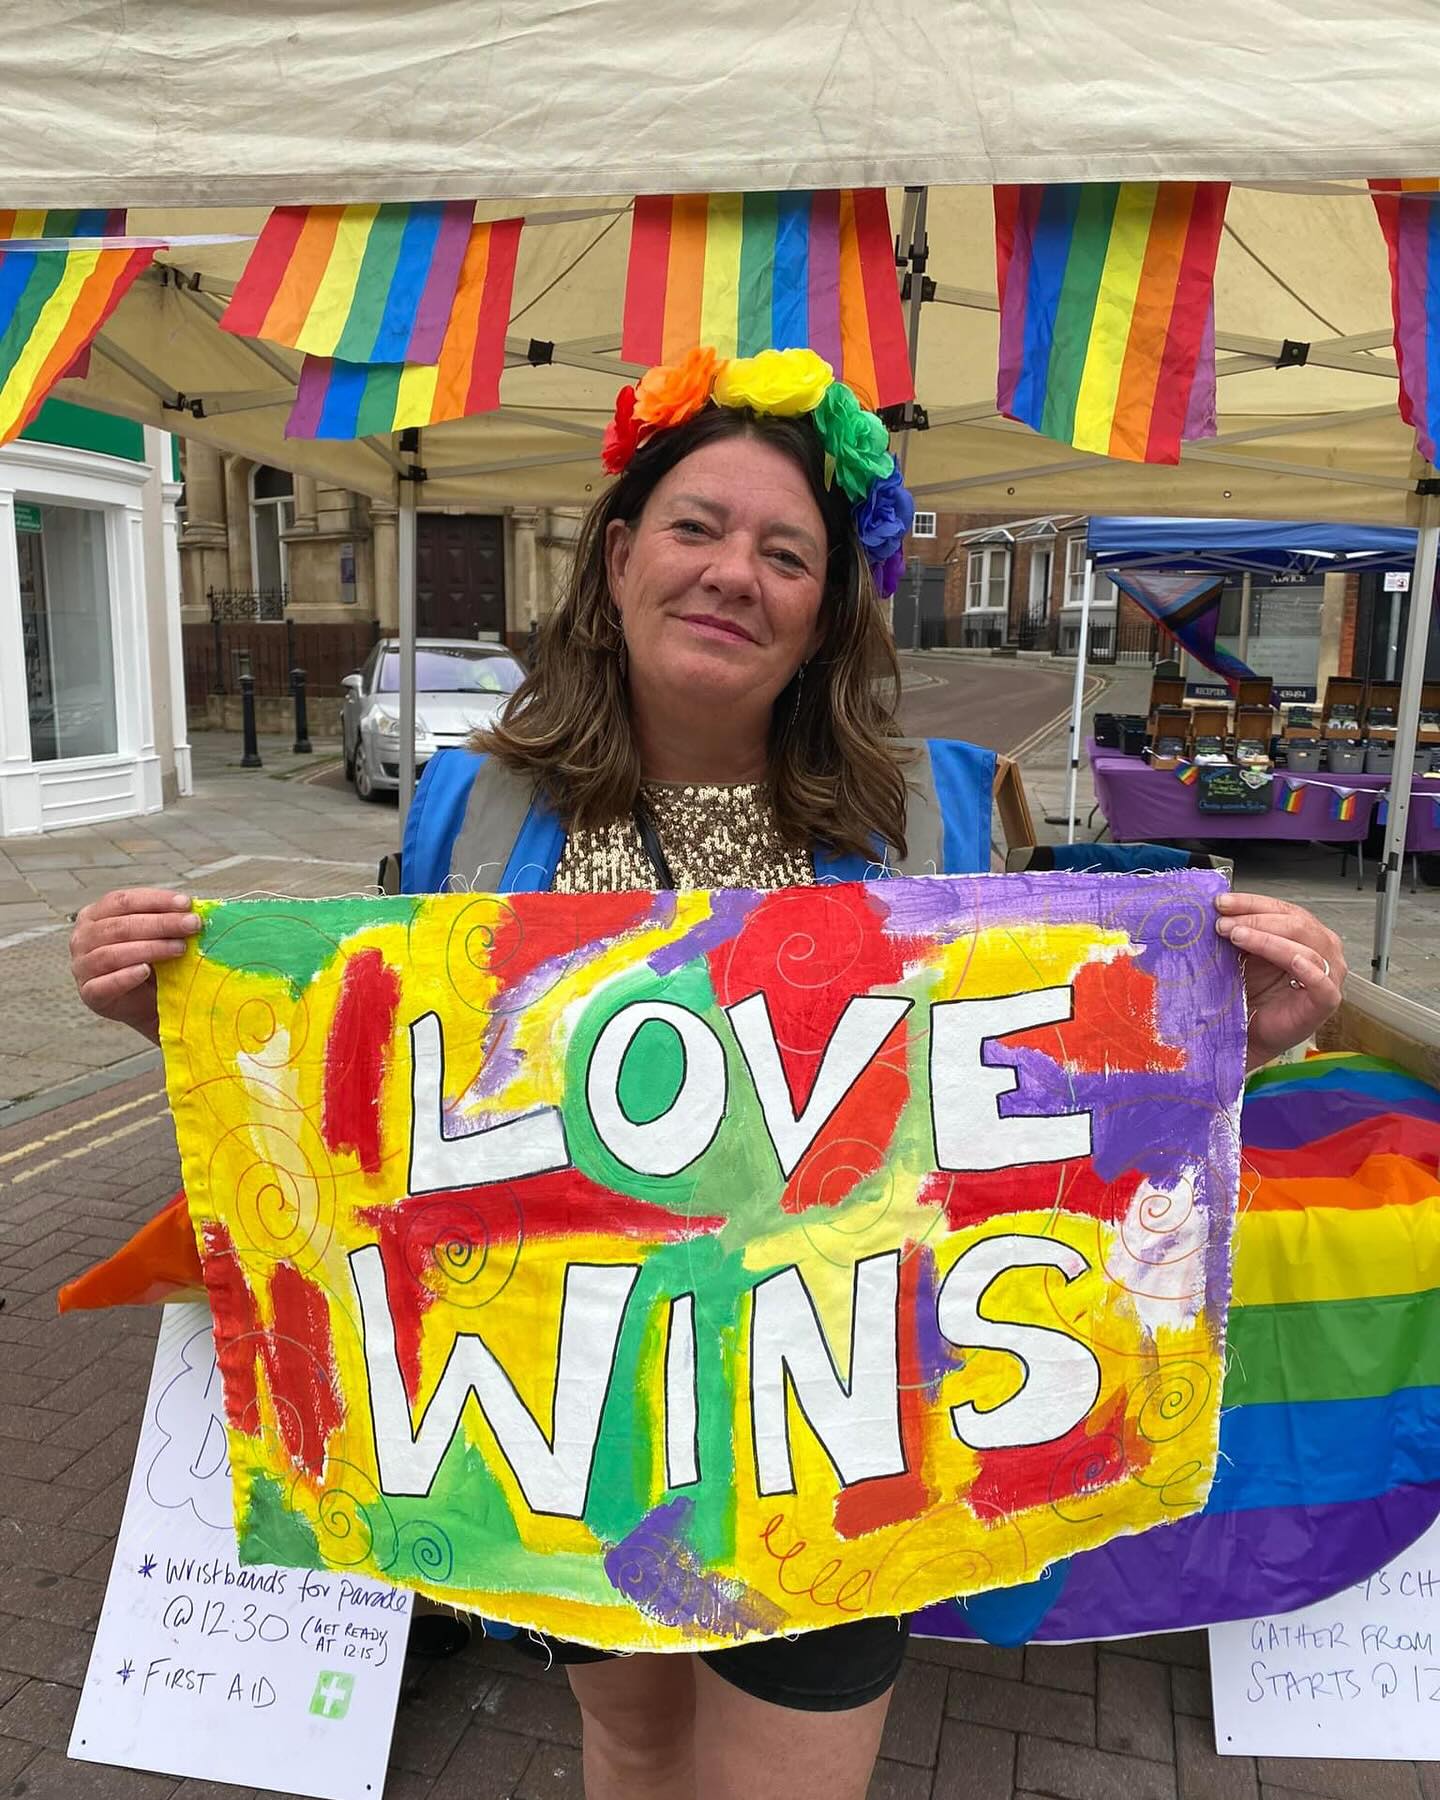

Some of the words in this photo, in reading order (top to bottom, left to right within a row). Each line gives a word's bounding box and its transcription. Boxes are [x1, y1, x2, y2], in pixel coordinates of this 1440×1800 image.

[408, 985, 1093, 1196] LOVE
[348, 1233, 1100, 1520] WINS
[165, 1557, 287, 1595] Wristbands
[298, 1568, 331, 1602] for
[315, 1636, 337, 1654] AT
[344, 1622, 389, 1647] READY
[1250, 1619, 1351, 1653] GATHER
[1361, 1624, 1433, 1655] FROM
[142, 1657, 217, 1697] FIRST
[227, 1673, 278, 1709] AID
[1247, 1660, 1361, 1703] STARTS
